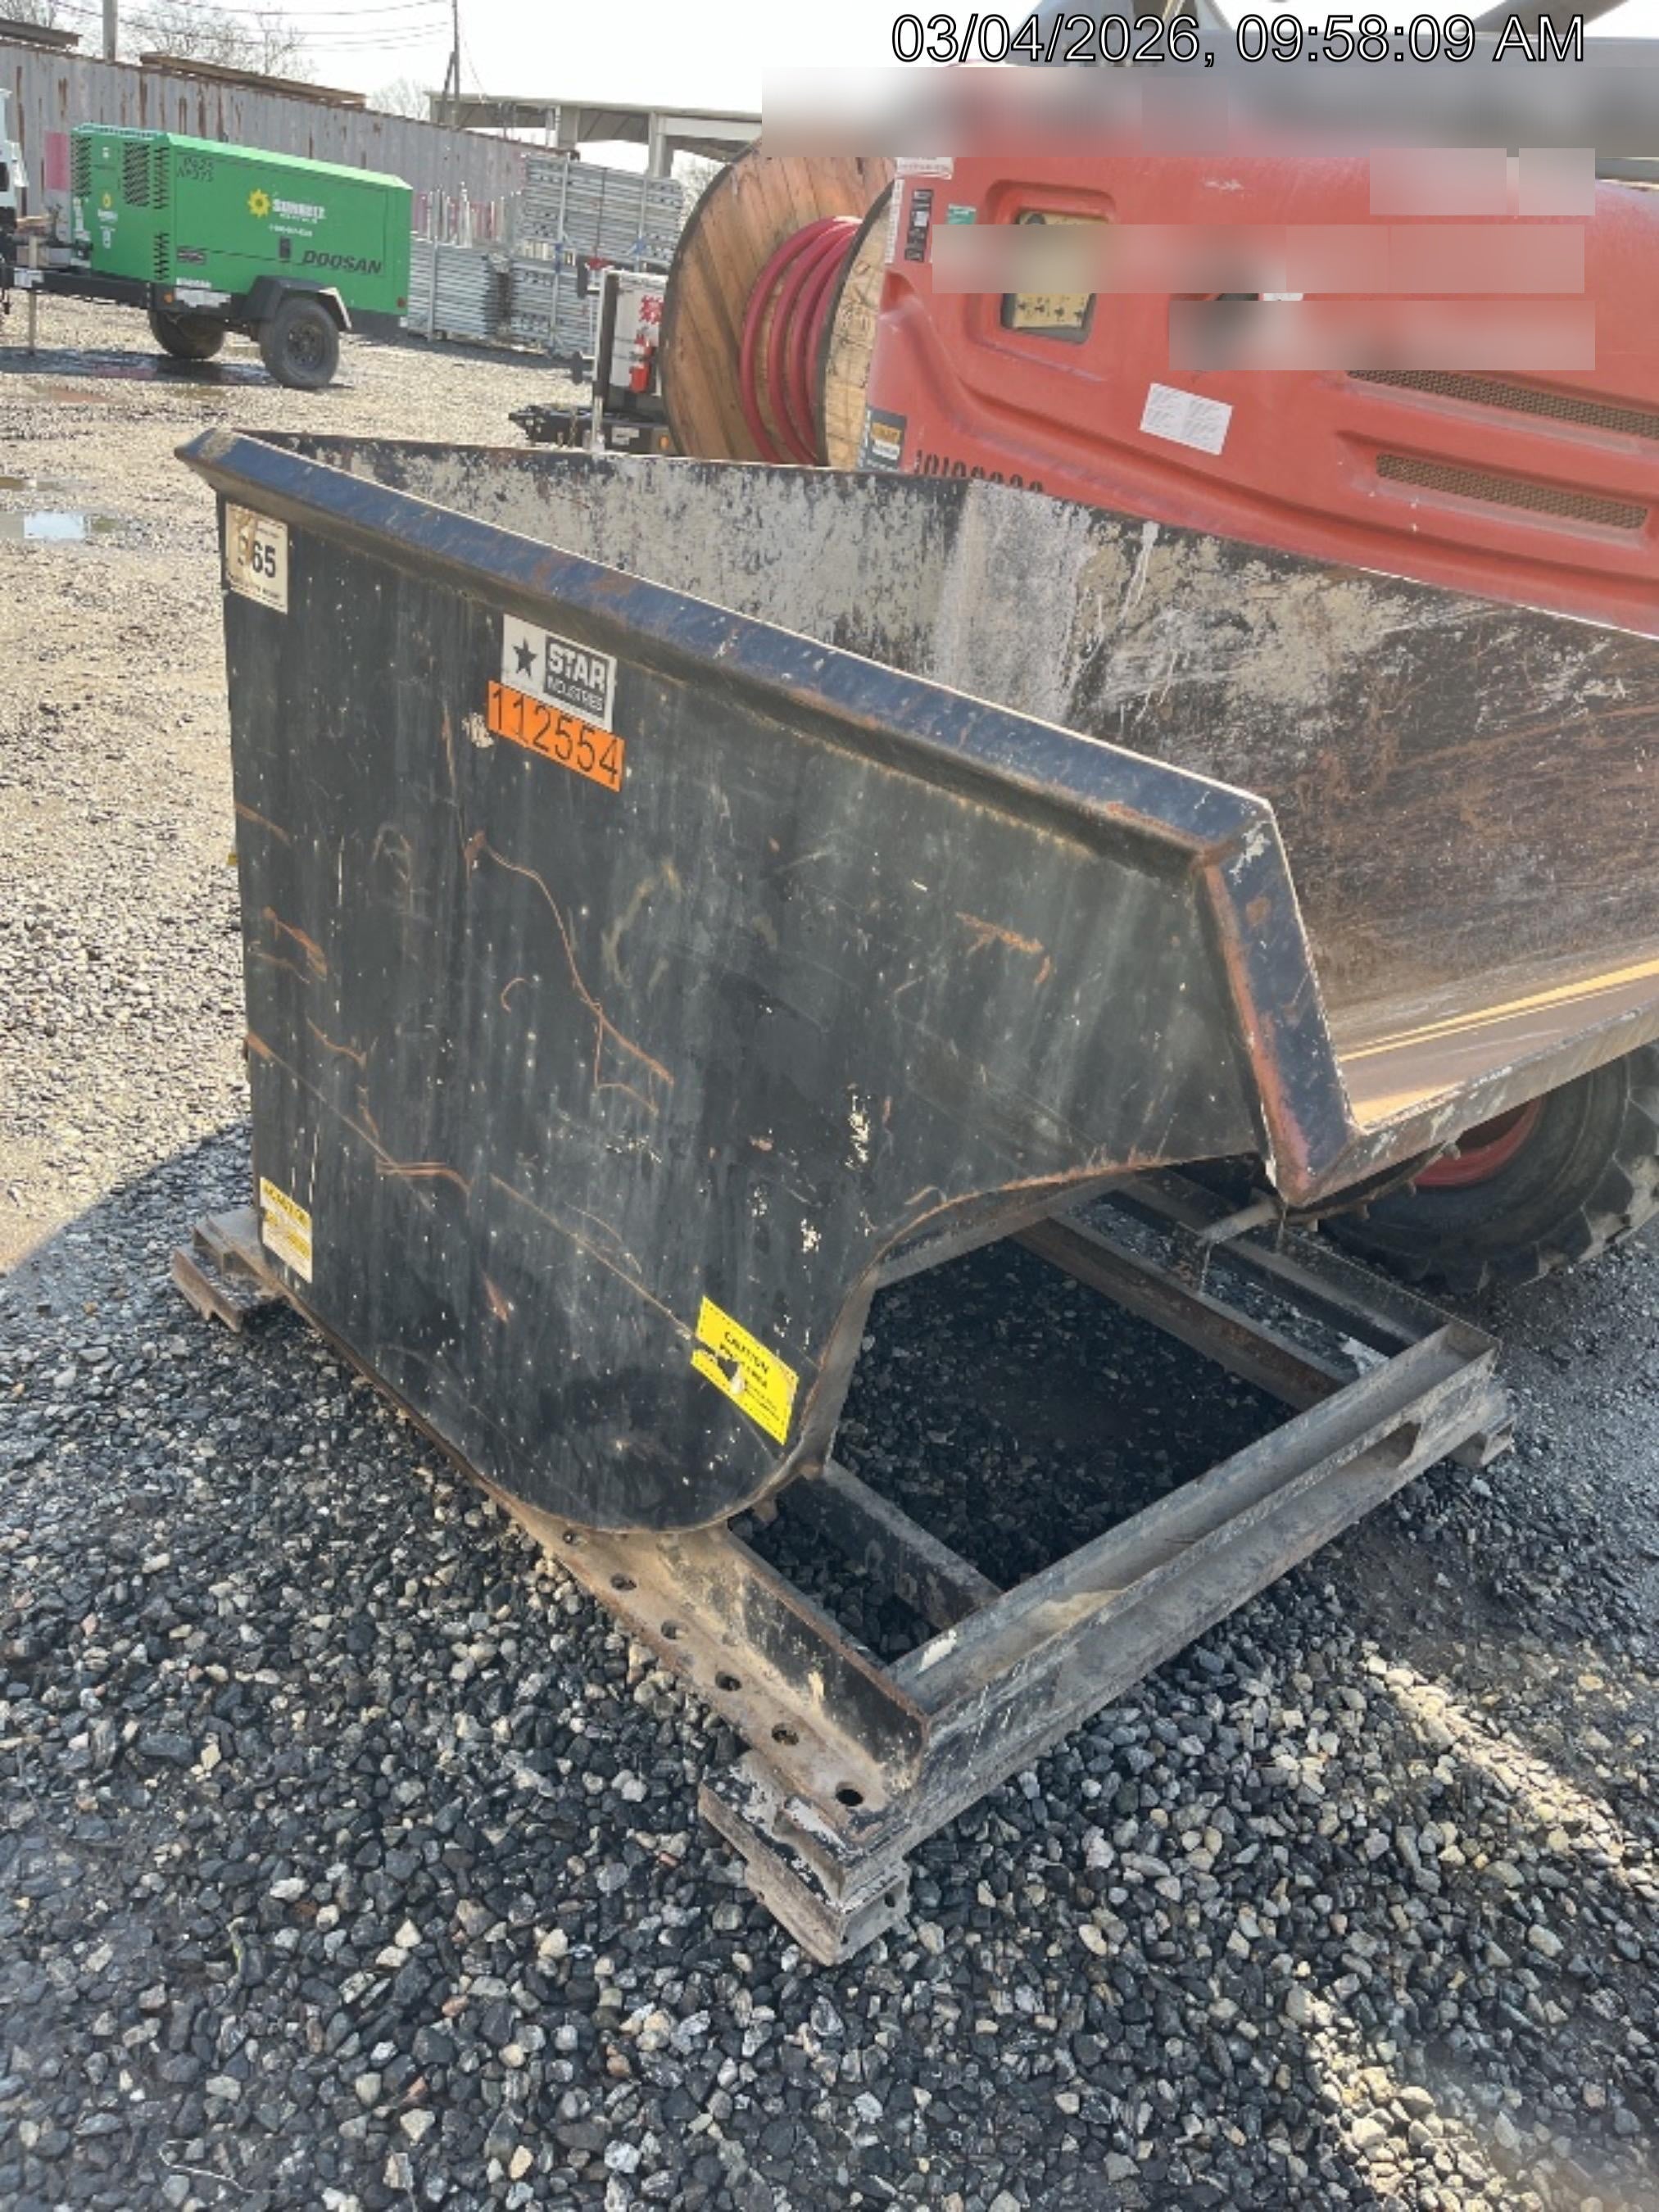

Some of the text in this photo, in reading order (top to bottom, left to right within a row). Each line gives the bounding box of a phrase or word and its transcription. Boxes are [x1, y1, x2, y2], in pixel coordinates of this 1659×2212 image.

[303, 250, 382, 274] DOOSAN
[549, 642, 605, 694] STAR
[492, 687, 618, 785] 112554
